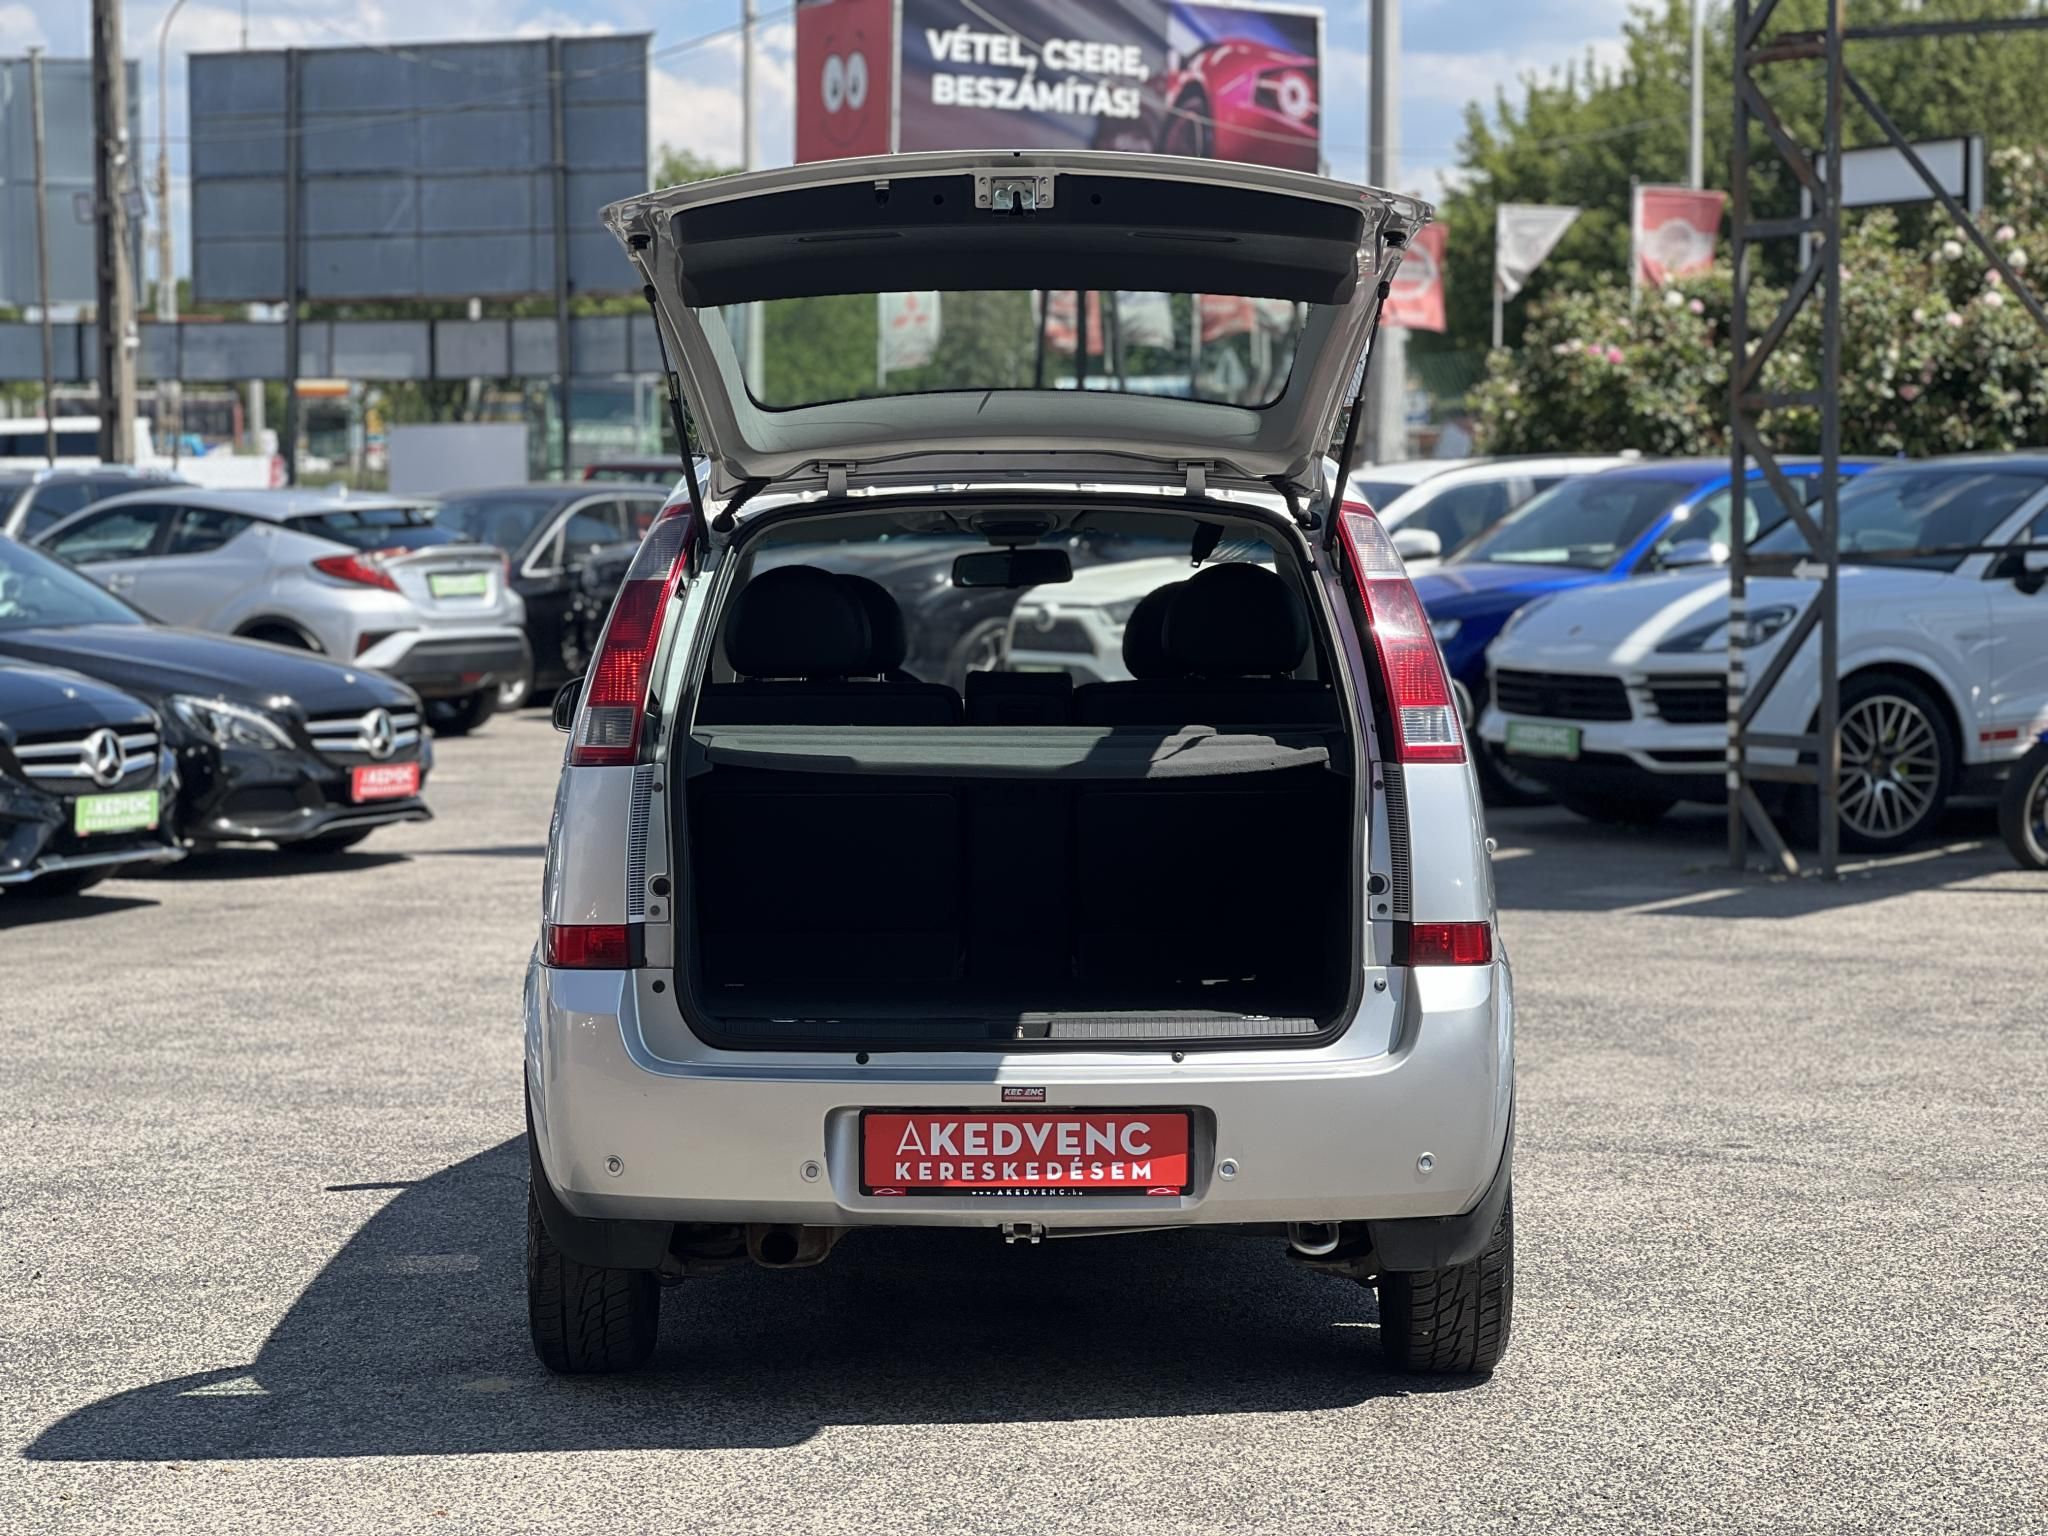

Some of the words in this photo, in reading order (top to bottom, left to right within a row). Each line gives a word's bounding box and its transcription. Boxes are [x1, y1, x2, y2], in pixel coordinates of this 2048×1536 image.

[925, 23, 1038, 72] VÉTEL,
[1043, 38, 1149, 82] CSERE,
[931, 73, 1140, 119] BESZÁMÍTÁS!
[896, 1120, 1151, 1156] AKEDVENC
[895, 1157, 1151, 1180] KERESKEDÉSEM
